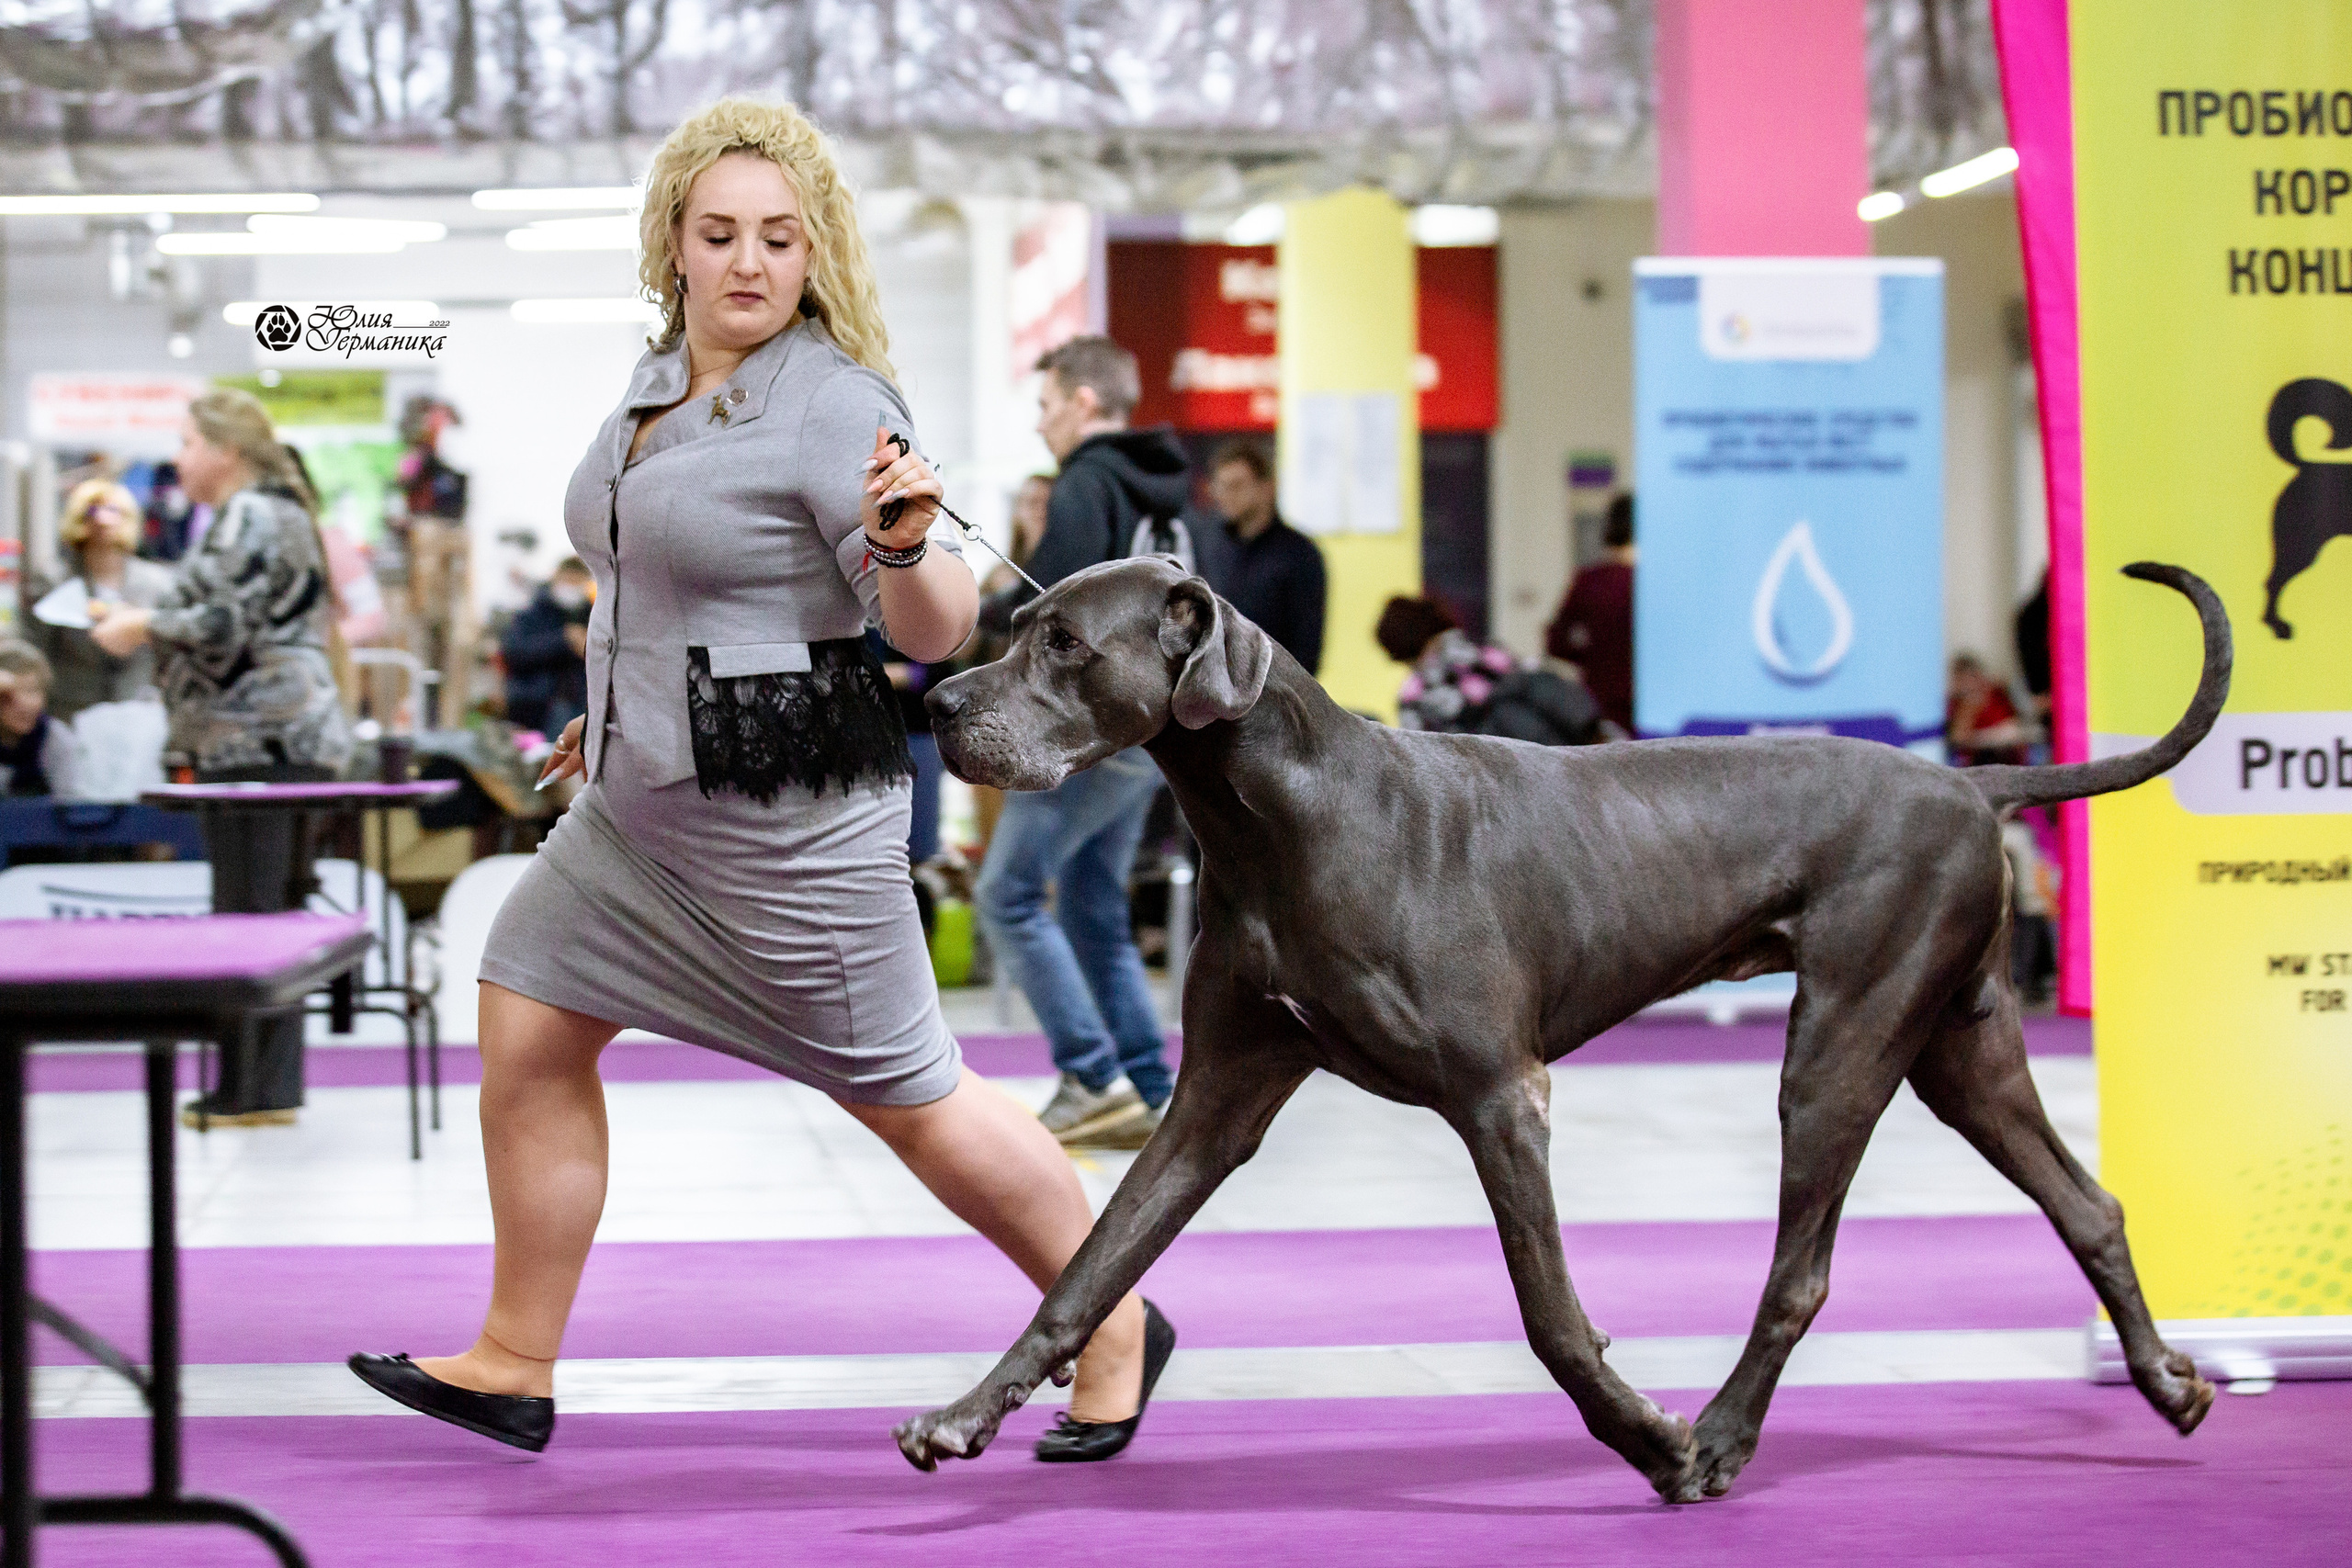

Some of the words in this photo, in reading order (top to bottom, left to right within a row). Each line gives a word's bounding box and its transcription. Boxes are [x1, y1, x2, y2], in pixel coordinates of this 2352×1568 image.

[2159, 89, 2352, 137] ПРОБИО
[2255, 169, 2352, 215] КОР
[2241, 738, 2352, 789] Prob
[2199, 855, 2350, 885] ПРИРОДНЫЙ
[2301, 989, 2346, 1011] FOR
